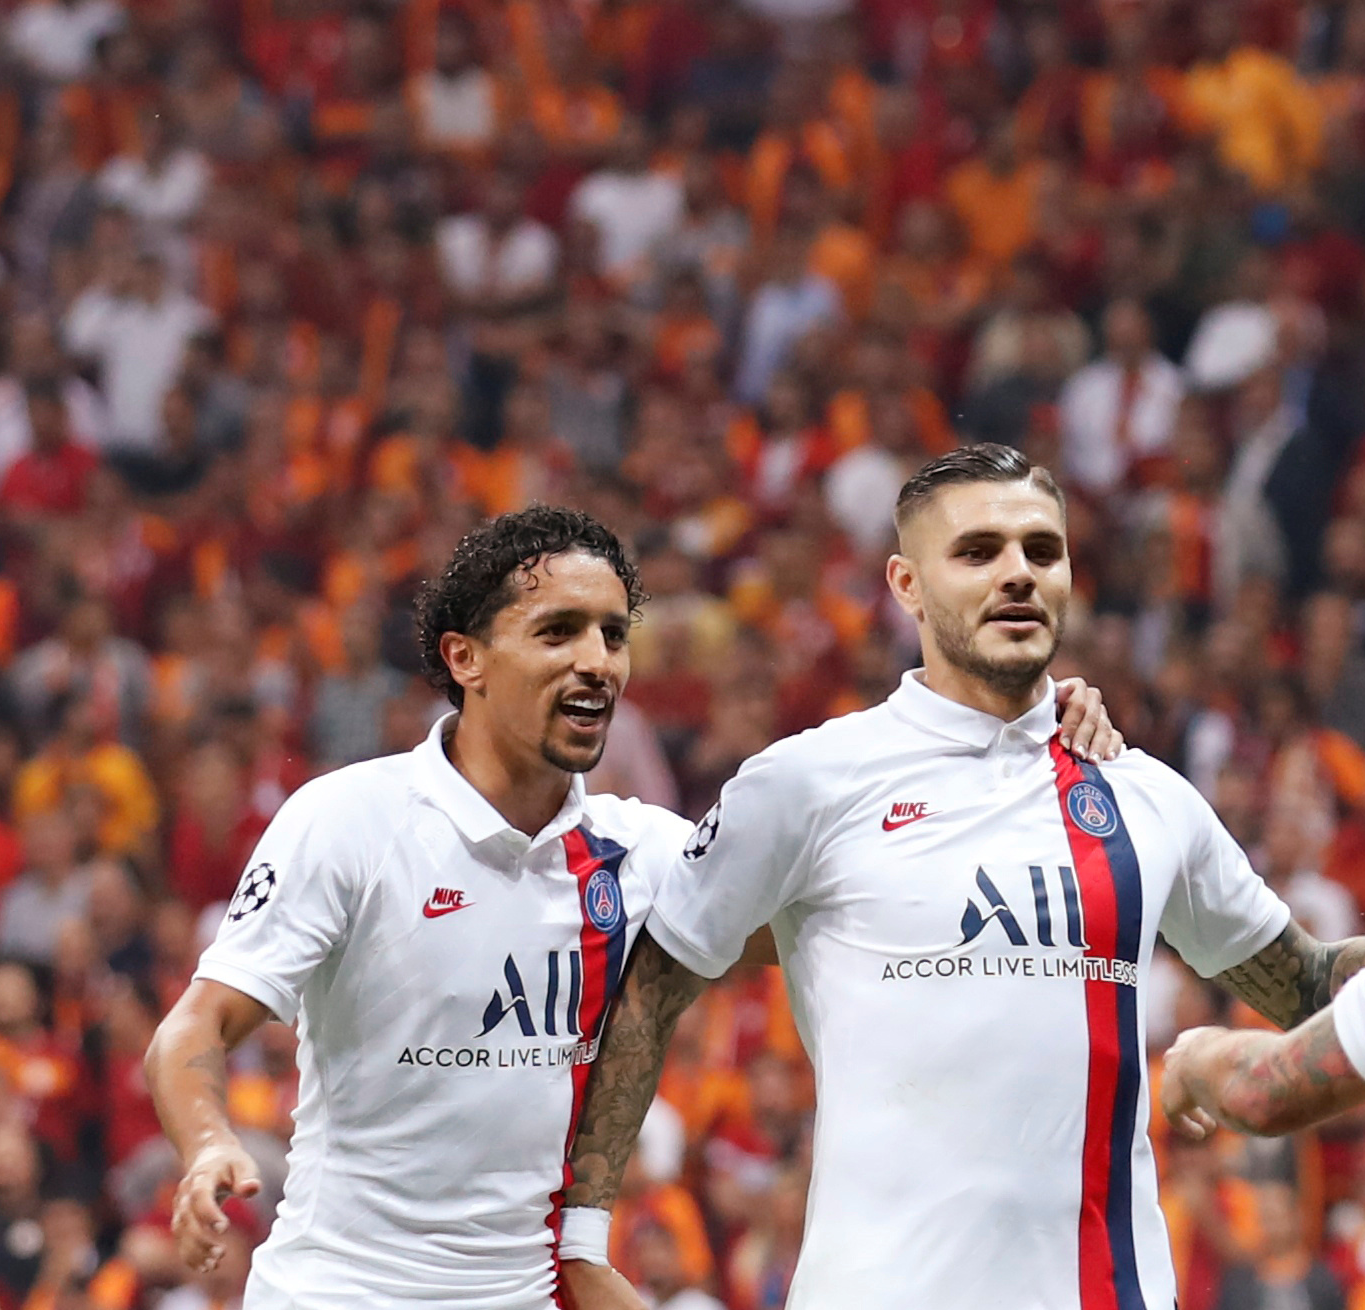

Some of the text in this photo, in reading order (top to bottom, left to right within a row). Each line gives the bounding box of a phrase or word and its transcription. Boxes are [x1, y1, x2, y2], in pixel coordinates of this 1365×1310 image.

[890, 802, 928, 817] NIKE
[431, 887, 465, 906] NIKE
[882, 957, 1138, 985] ACCOR LIVE LIMITLESS
[398, 1047, 490, 1067] ACCOR
[498, 1047, 542, 1067] LIVE
